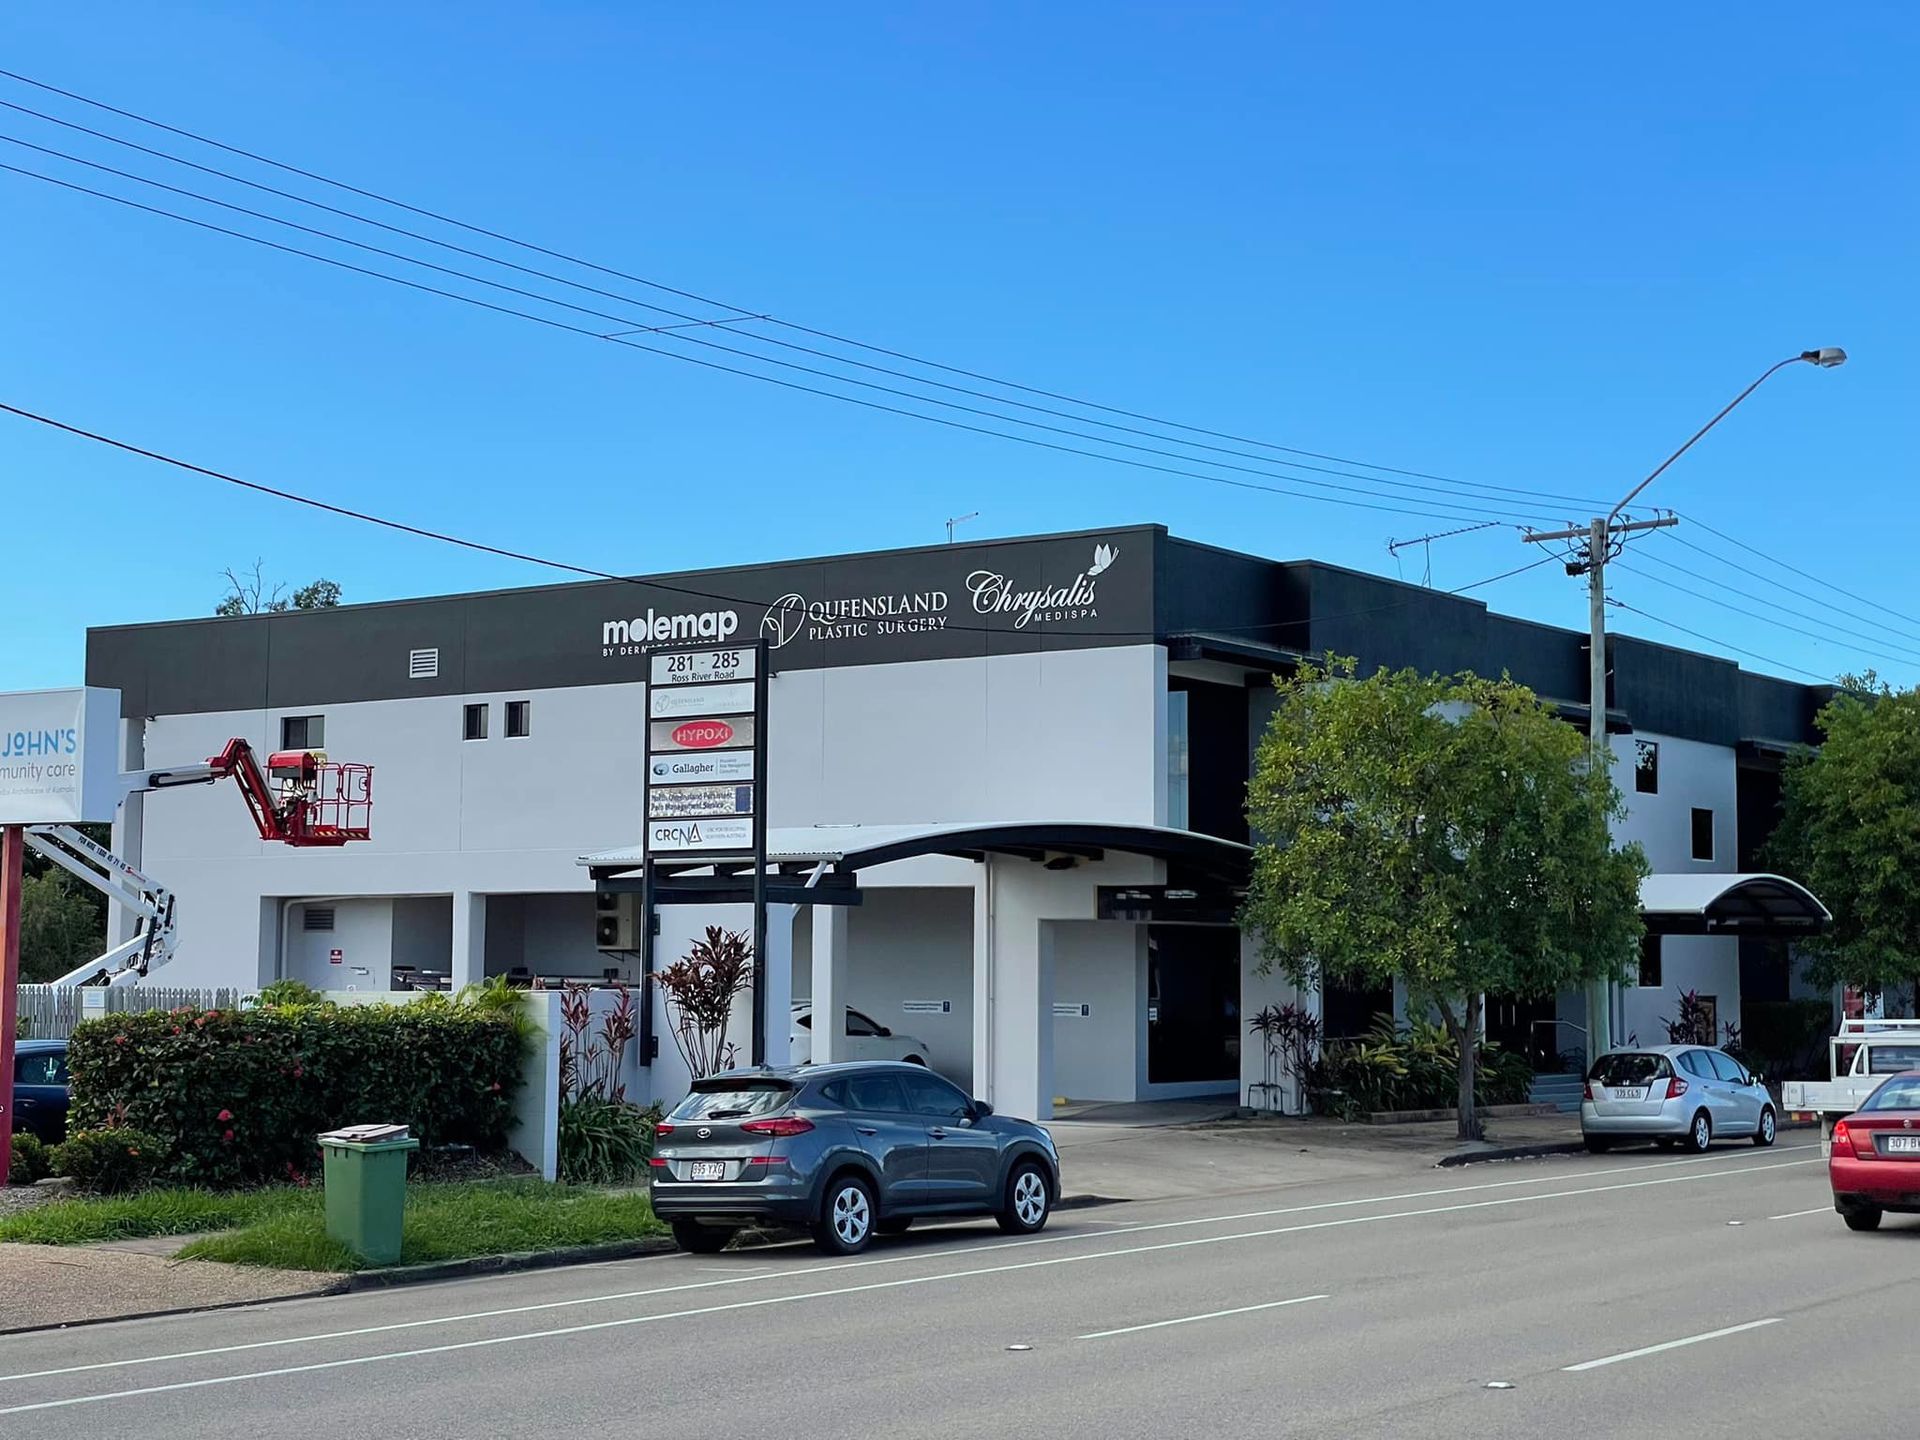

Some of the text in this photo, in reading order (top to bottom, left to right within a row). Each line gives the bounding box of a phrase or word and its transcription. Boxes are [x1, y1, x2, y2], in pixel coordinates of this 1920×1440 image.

[966, 570, 1096, 629] Chrysalis
[808, 591, 949, 625] QUEENSLAND
[1034, 609, 1098, 622] MEDISPA
[603, 608, 739, 645] molemap
[809, 616, 948, 640] PLASTIC SURGERY
[602, 647, 614, 657] BY
[667, 655, 694, 673] 281
[712, 651, 740, 669] 285
[671, 669, 735, 683] Ross River Road
[46, 763, 76, 777] care
[672, 763, 714, 774] Gallagher
[1890, 1137, 1907, 1148] 307
